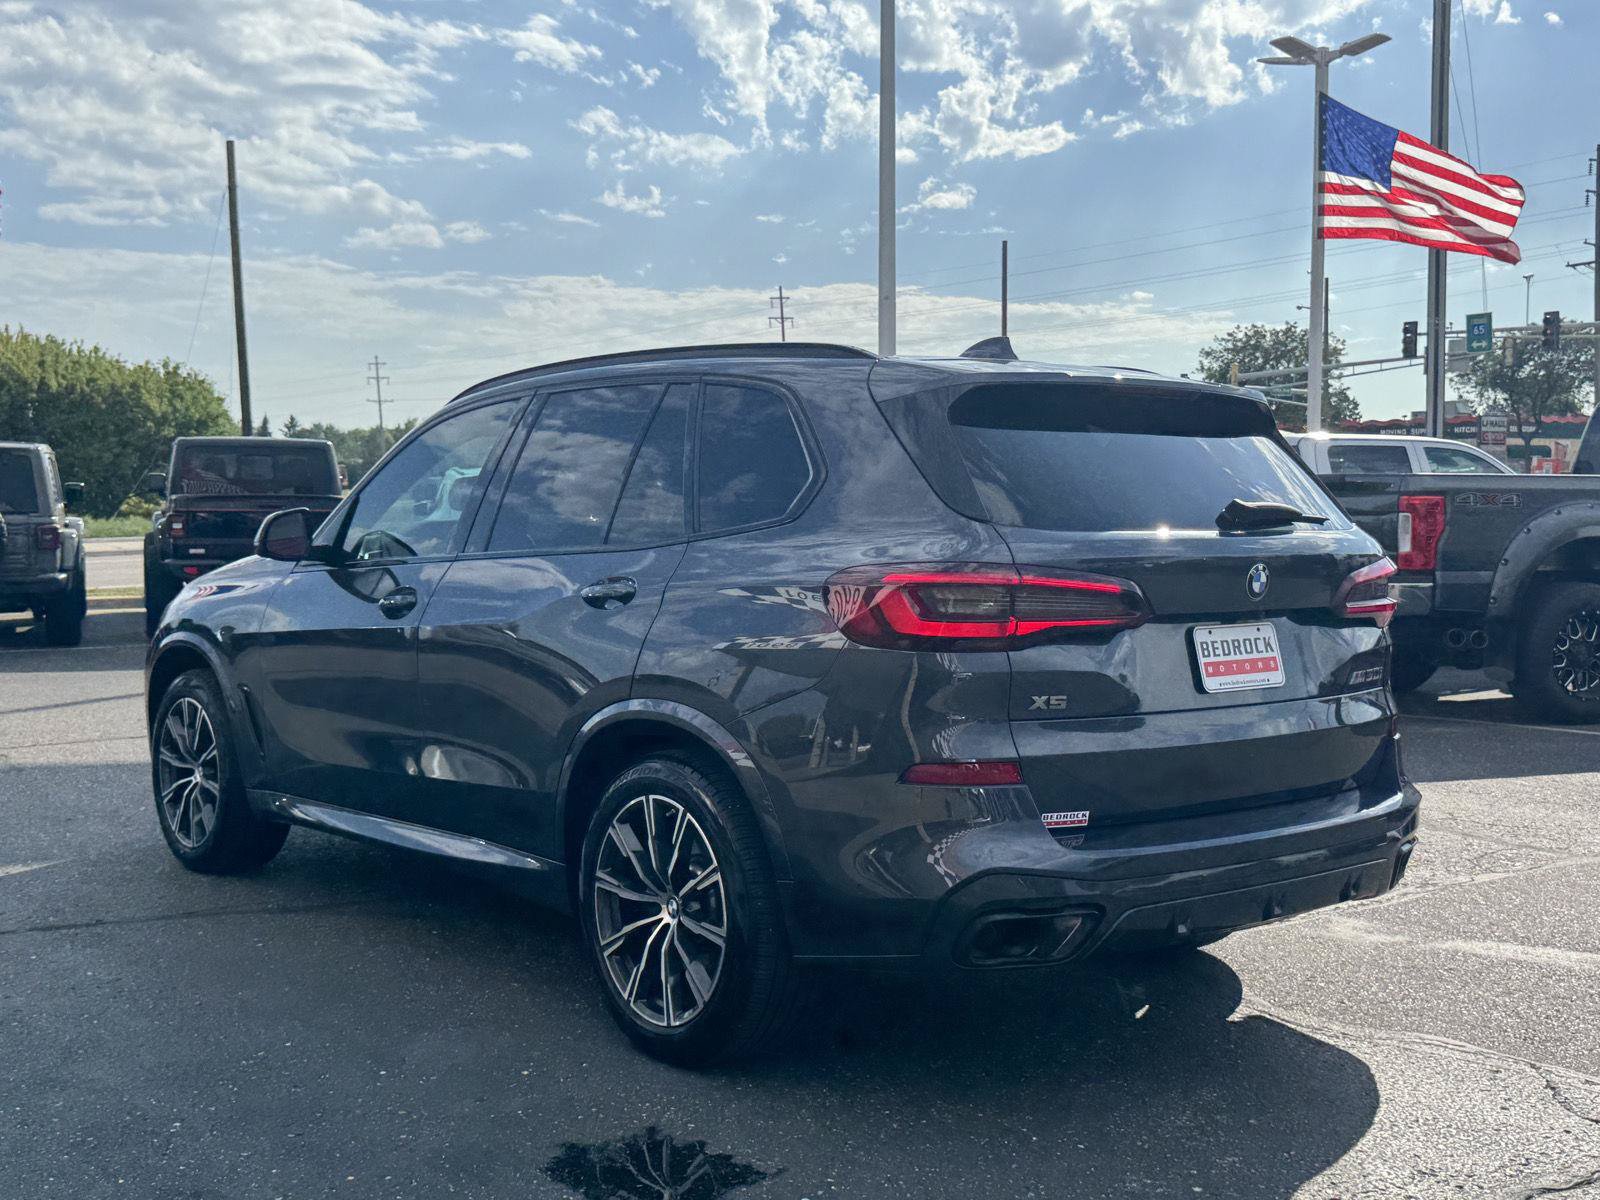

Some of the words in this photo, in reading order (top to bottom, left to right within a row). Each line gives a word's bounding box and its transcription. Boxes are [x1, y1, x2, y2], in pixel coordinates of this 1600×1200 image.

[1473, 325, 1485, 335] 65
[1200, 636, 1274, 658] BEDROCK
[1207, 660, 1275, 673] MOTORS
[1027, 695, 1067, 710] X5
[1042, 812, 1087, 821] BEDROCK
